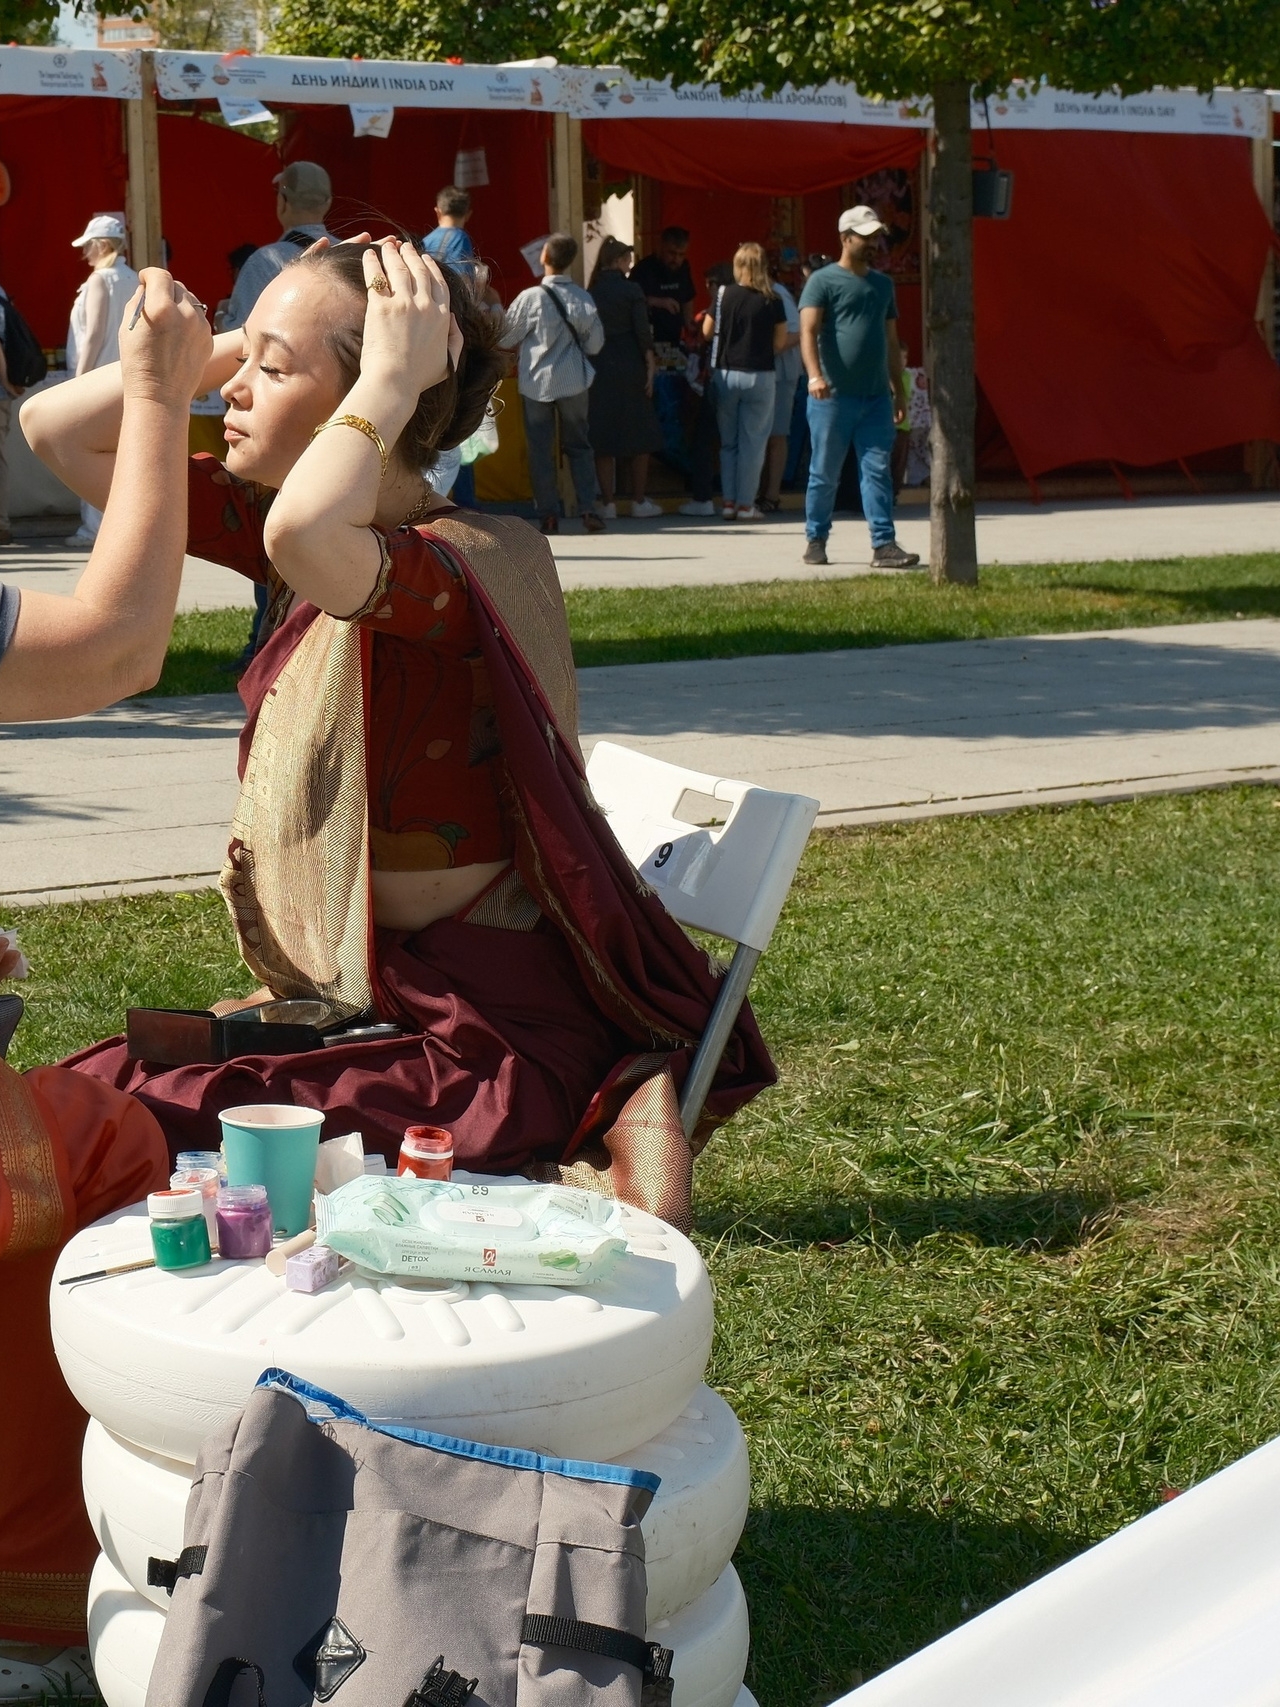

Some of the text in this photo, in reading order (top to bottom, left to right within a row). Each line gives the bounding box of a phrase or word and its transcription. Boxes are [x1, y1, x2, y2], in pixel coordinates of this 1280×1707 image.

[291, 73, 328, 86] ДЕНЬ
[331, 75, 380, 89] ИНДИИ
[389, 78, 427, 91] INDIA
[429, 79, 454, 92] DAY
[675, 90, 719, 102] GANDHI
[654, 842, 673, 868] 9
[401, 1254, 429, 1262] DETOX
